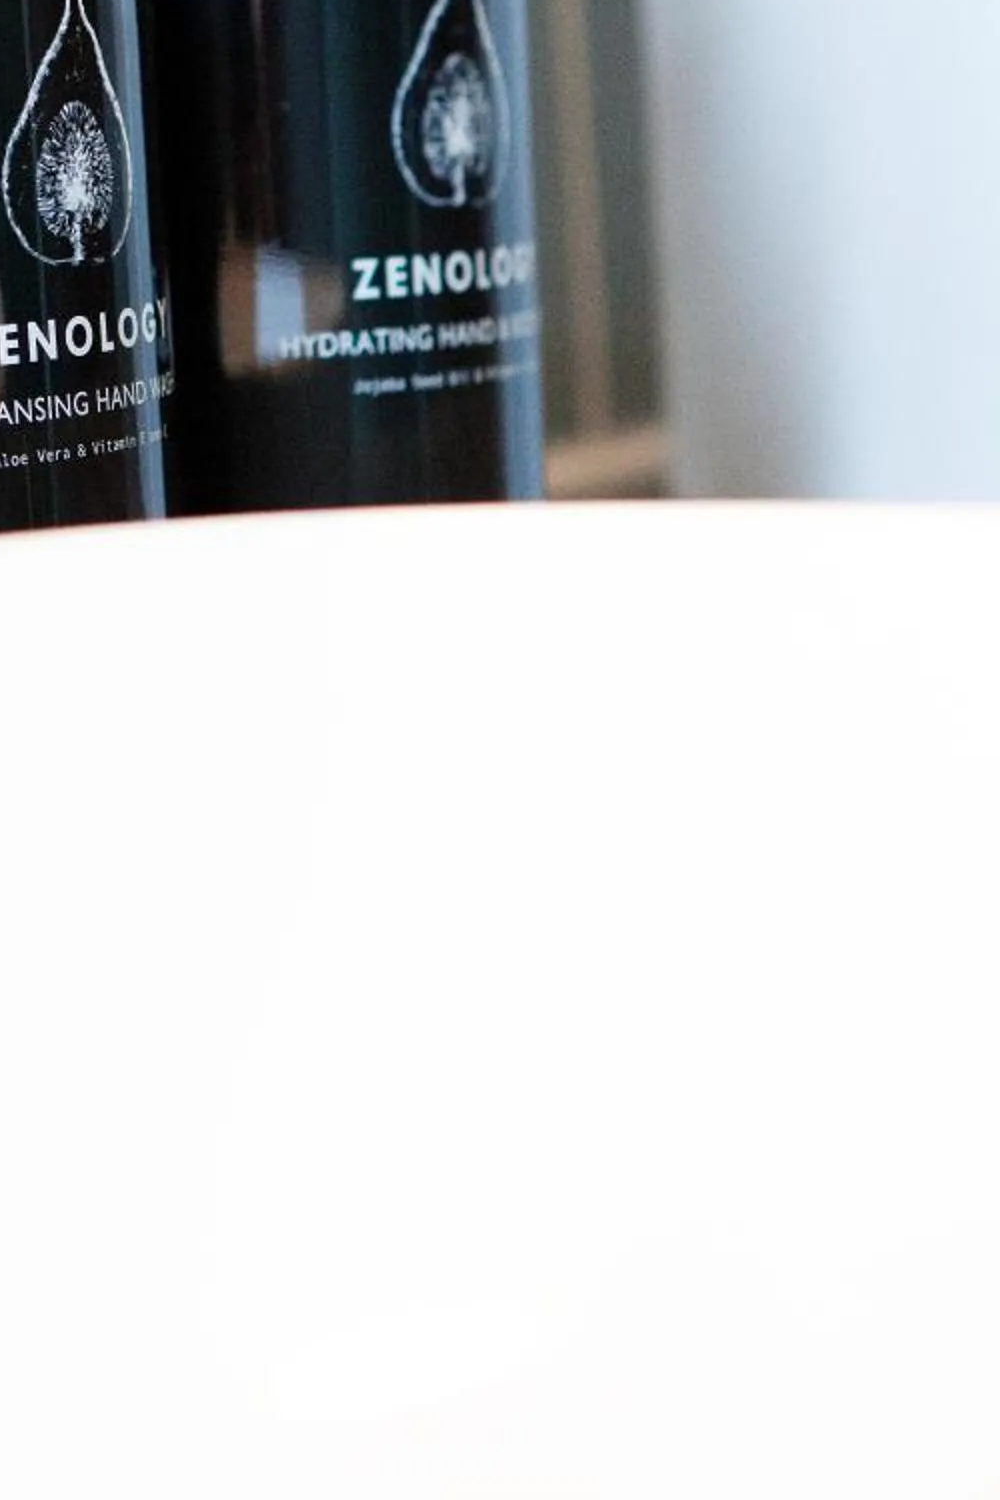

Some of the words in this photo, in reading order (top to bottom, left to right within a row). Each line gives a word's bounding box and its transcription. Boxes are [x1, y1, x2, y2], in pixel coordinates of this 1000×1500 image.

[352, 242, 537, 300] ZENOLO
[279, 323, 435, 360] HYDRATING
[96, 379, 147, 414] HAND
[36, 447, 71, 463] Vera
[77, 443, 88, 458] &
